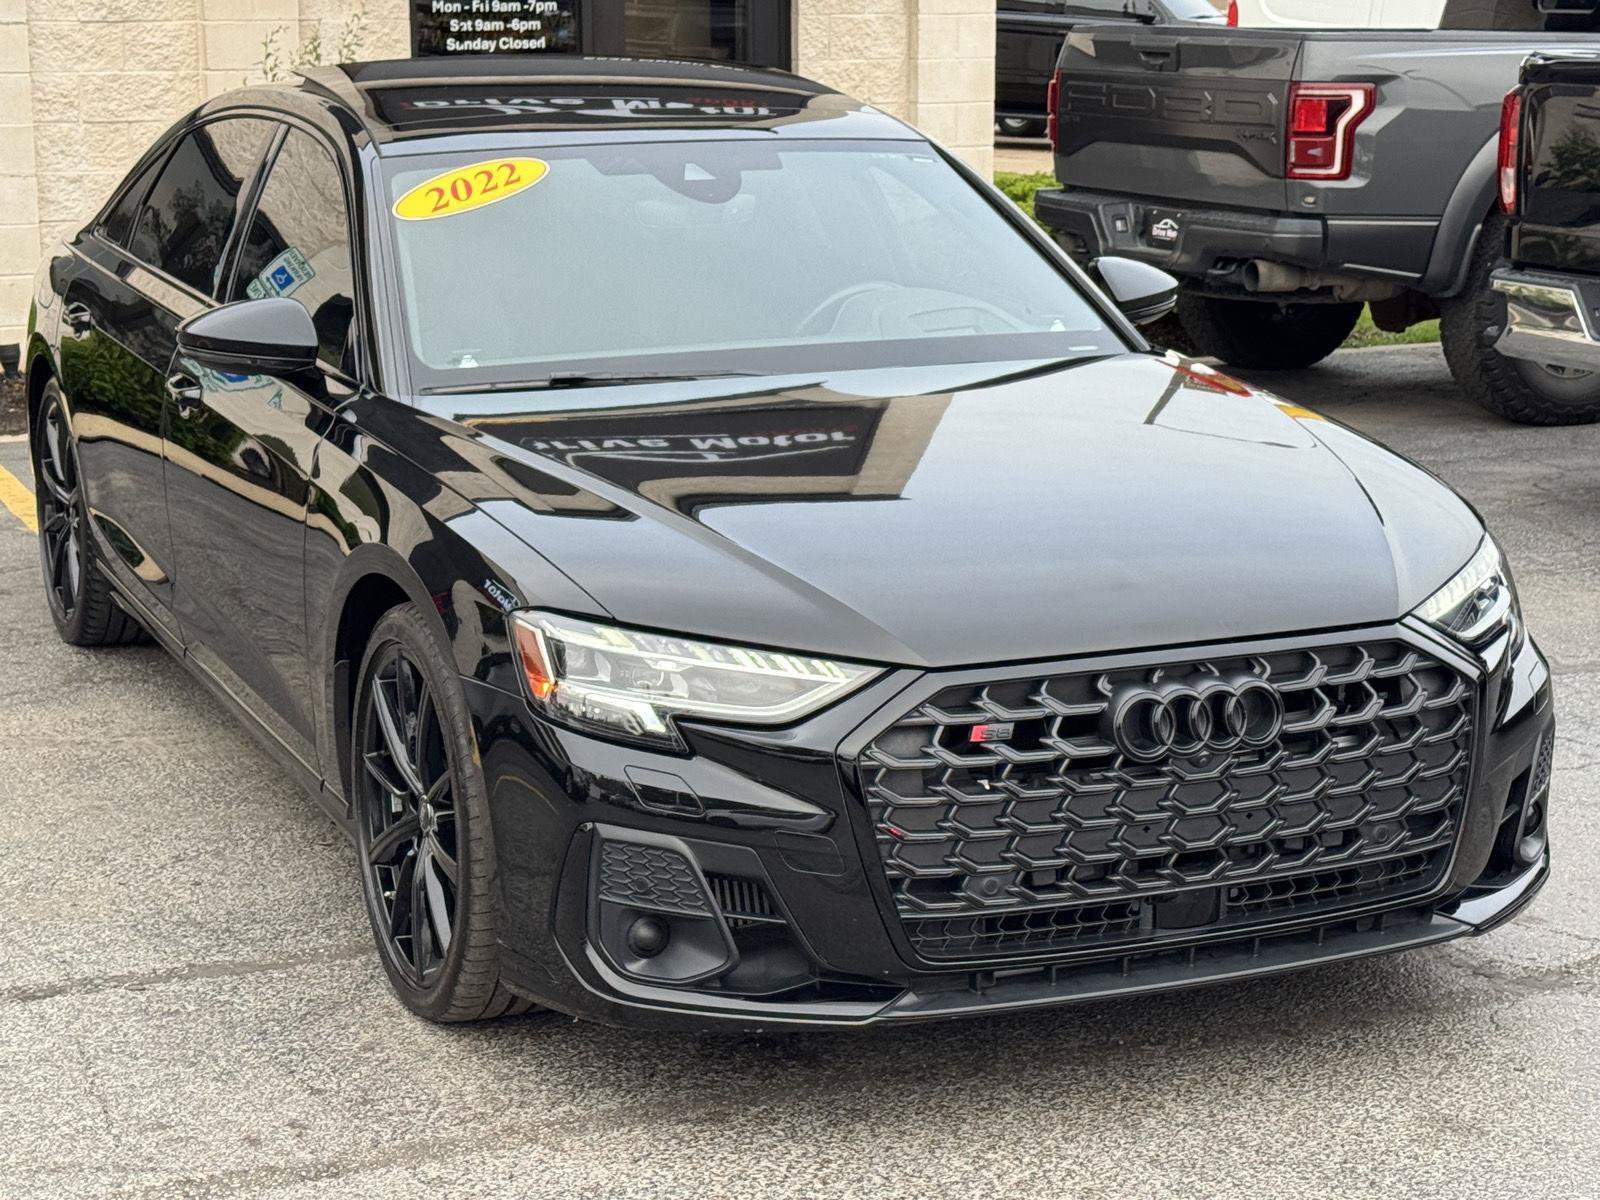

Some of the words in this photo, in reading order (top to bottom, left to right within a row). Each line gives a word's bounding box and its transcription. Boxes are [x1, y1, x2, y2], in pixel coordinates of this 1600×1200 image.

[432, 0, 461, 13] Mon
[491, 0, 521, 12] 9am
[523, 0, 557, 15] -7pm
[474, 18, 504, 31] 9am
[507, 18, 541, 33] -6pm
[446, 37, 496, 52] Sunday
[499, 36, 545, 49] Closed
[425, 162, 521, 213] 2022
